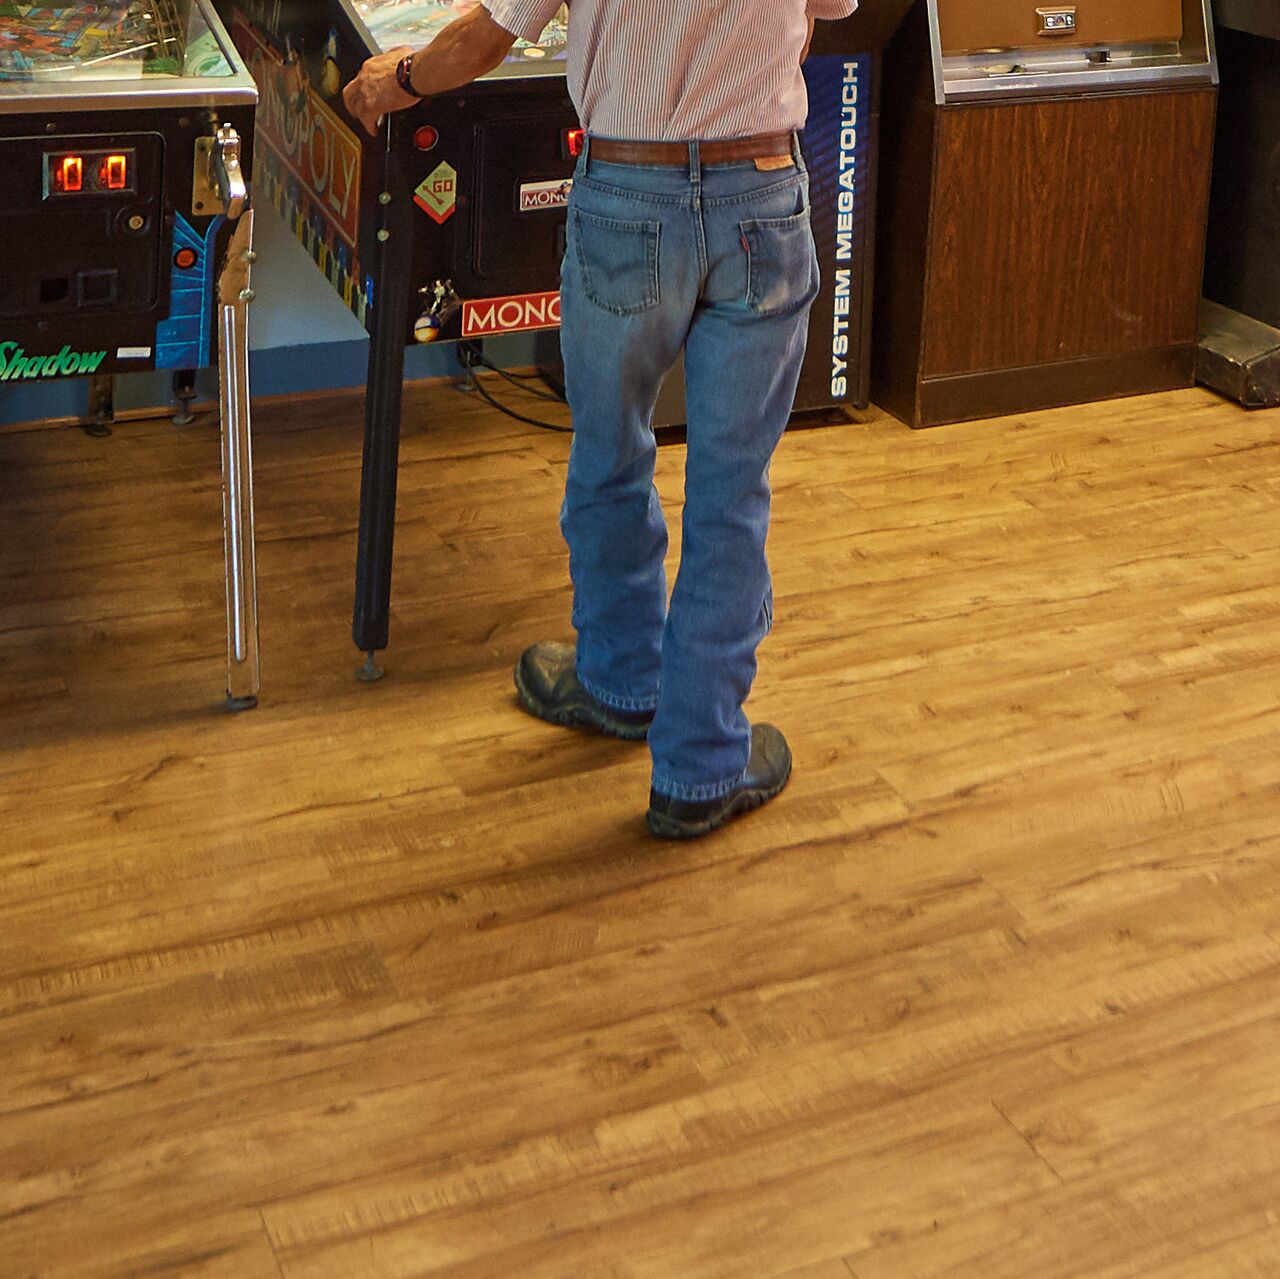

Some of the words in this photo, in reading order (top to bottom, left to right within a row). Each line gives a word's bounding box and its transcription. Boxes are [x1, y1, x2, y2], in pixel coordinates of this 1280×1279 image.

[432, 179, 453, 193] GO
[836, 61, 858, 260] MEGATOUCH
[467, 296, 561, 332] MONO
[831, 269, 851, 398] SYSTEM
